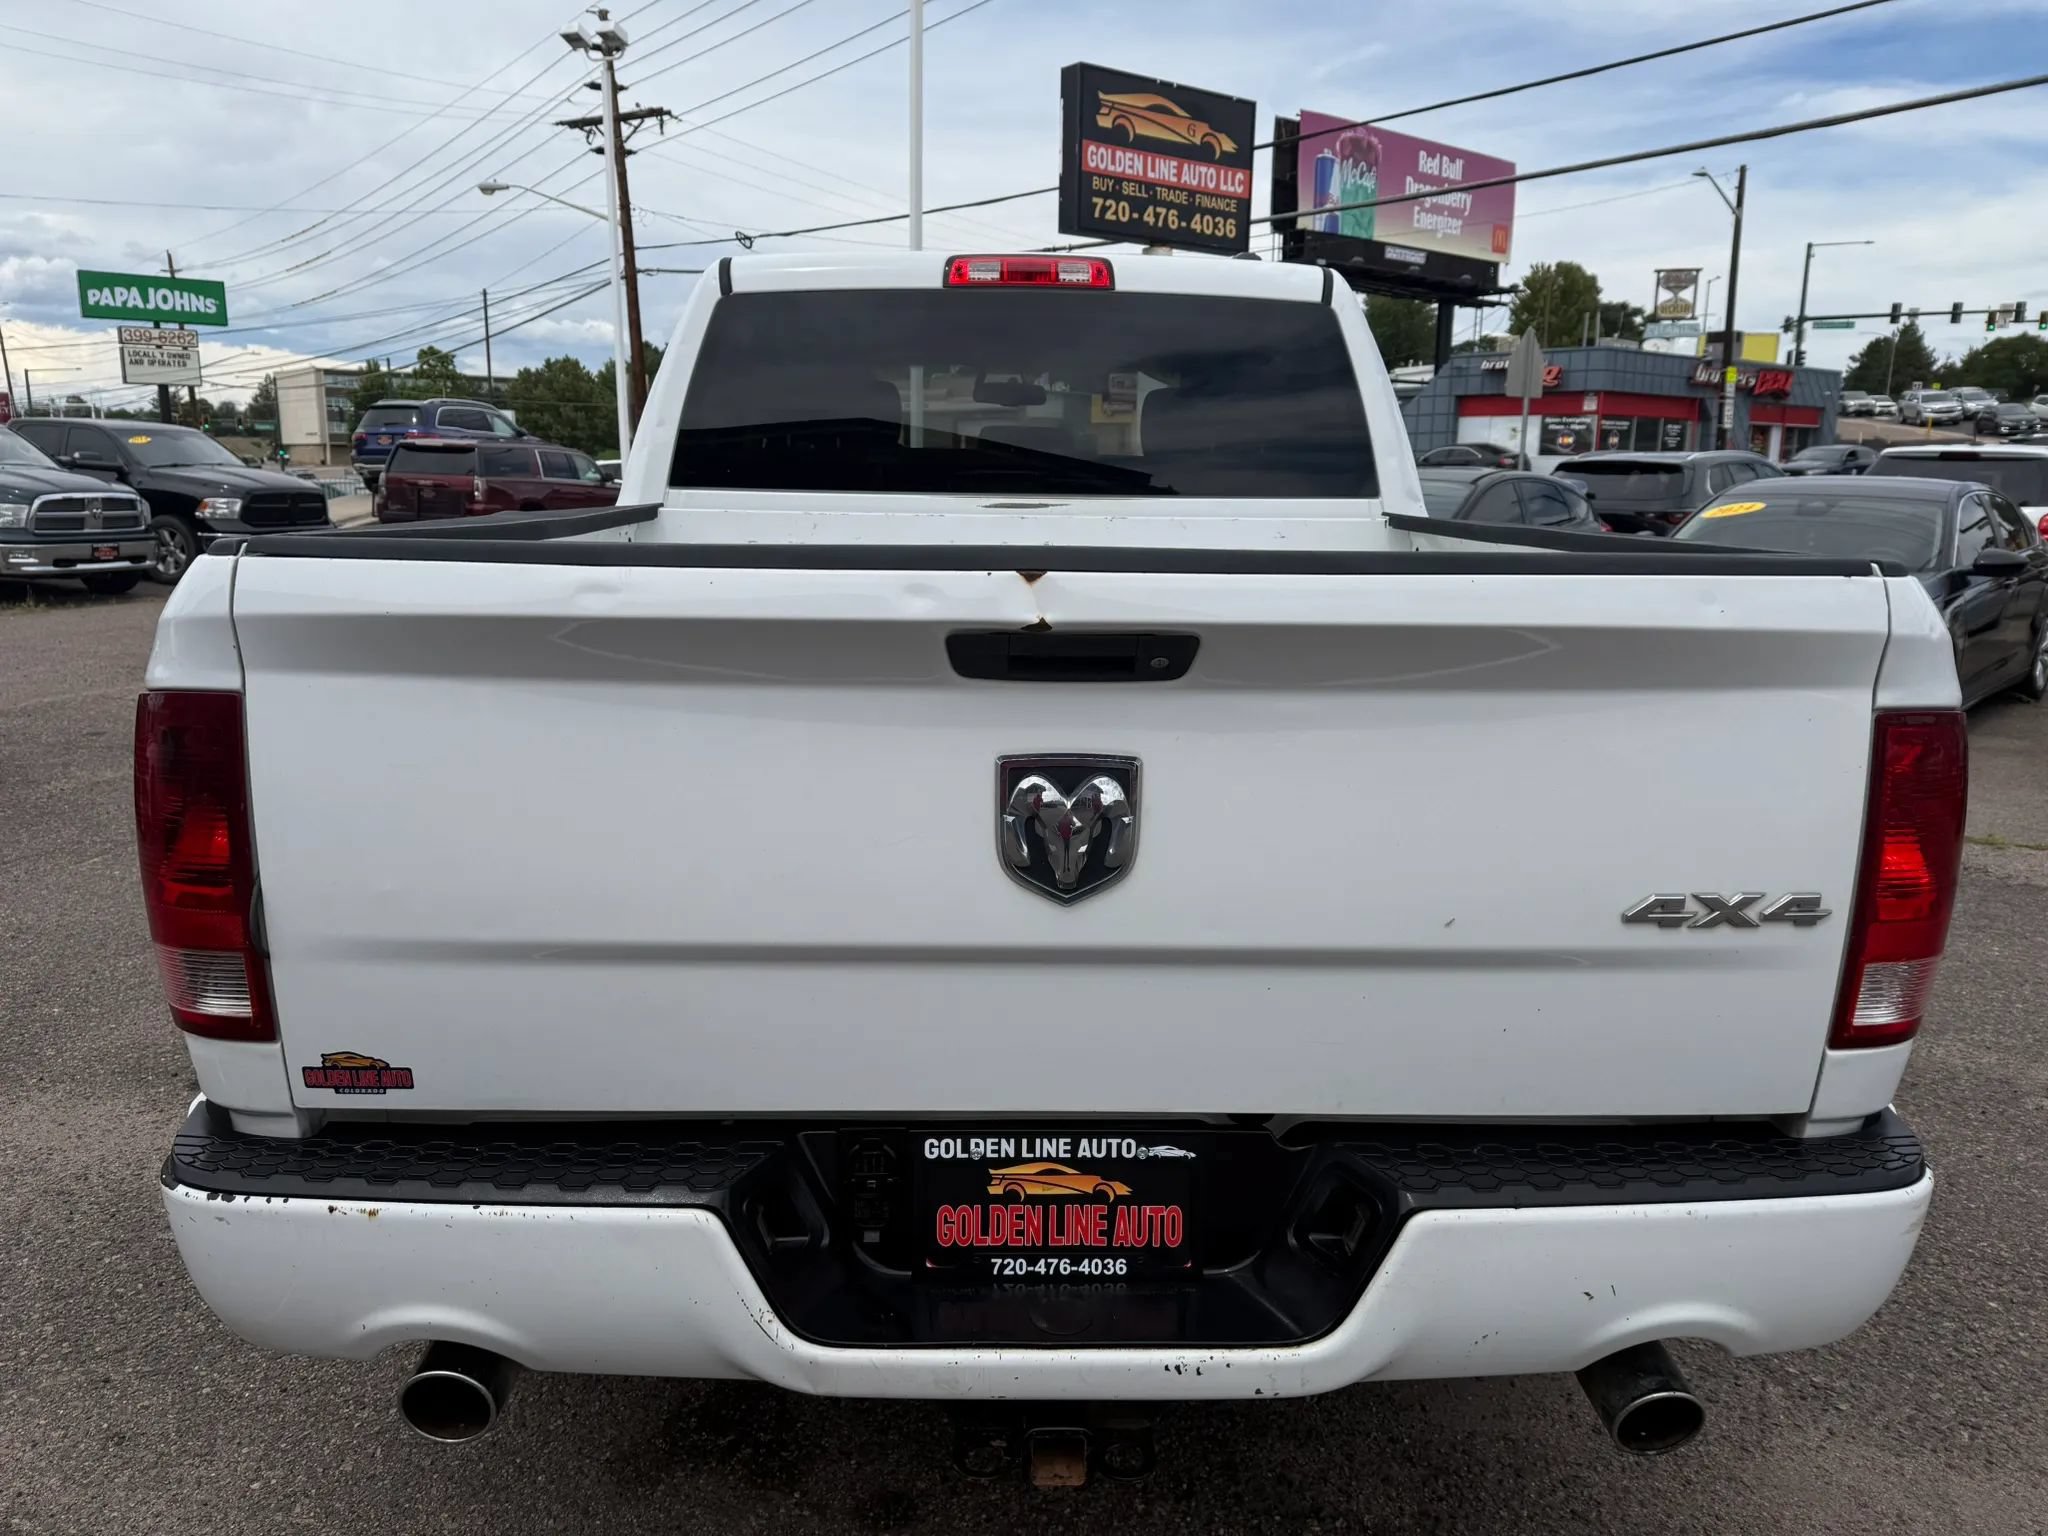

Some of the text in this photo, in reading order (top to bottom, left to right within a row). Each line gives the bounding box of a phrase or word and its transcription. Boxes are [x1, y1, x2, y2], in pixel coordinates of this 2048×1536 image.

[1087, 145, 1245, 194] GOLDEN LINE AUTO LLC
[1418, 150, 1464, 179] Red Bull
[1092, 176, 1238, 213] BUY SELL TRADE FINANCE
[1412, 206, 1463, 239] Energizer
[87, 286, 217, 314] PAPA JOHNS
[123, 329, 196, 346] 399-6262
[129, 358, 188, 368] AND OPERATED
[303, 1068, 412, 1087] GOLDEN LINE AUTO
[924, 1138, 1137, 1160] GOLDEN LINE AUTO
[936, 1204, 1183, 1248] GOLDEN LINE AUTO
[990, 1258, 1128, 1276] 720-476-4036
